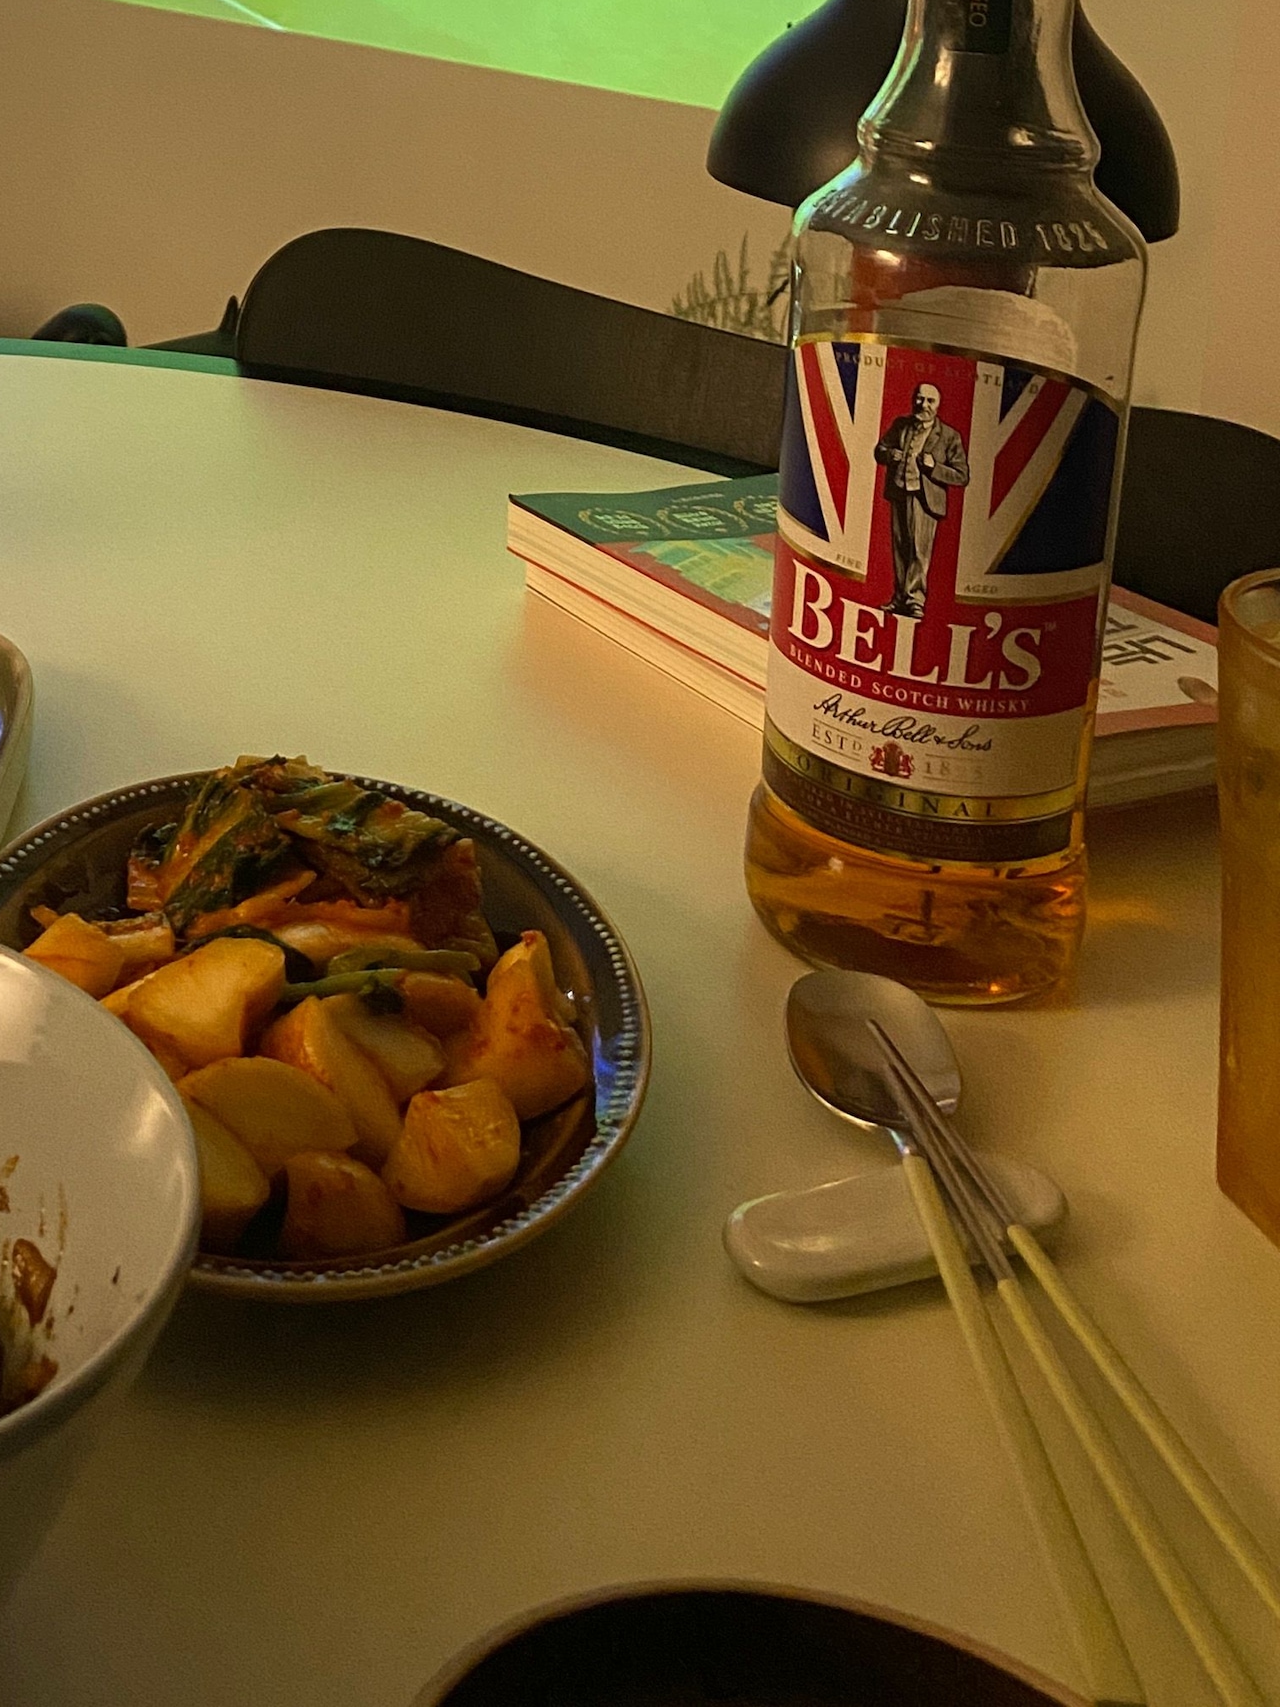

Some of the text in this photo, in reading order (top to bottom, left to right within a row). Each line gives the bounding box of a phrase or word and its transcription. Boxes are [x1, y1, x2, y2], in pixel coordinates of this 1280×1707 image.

[813, 188, 1017, 249] ESTABLISHED
[835, 553, 861, 570] FINE
[963, 584, 999, 595] AGED
[788, 559, 1042, 692] BELL'S
[788, 644, 1030, 713] BLENDED SCOTCH WHISKY
[814, 694, 883, 732] Arthur
[881, 715, 933, 745] Bell
[947, 724, 993, 752] Sons
[795, 752, 995, 818] ORIGINAL
